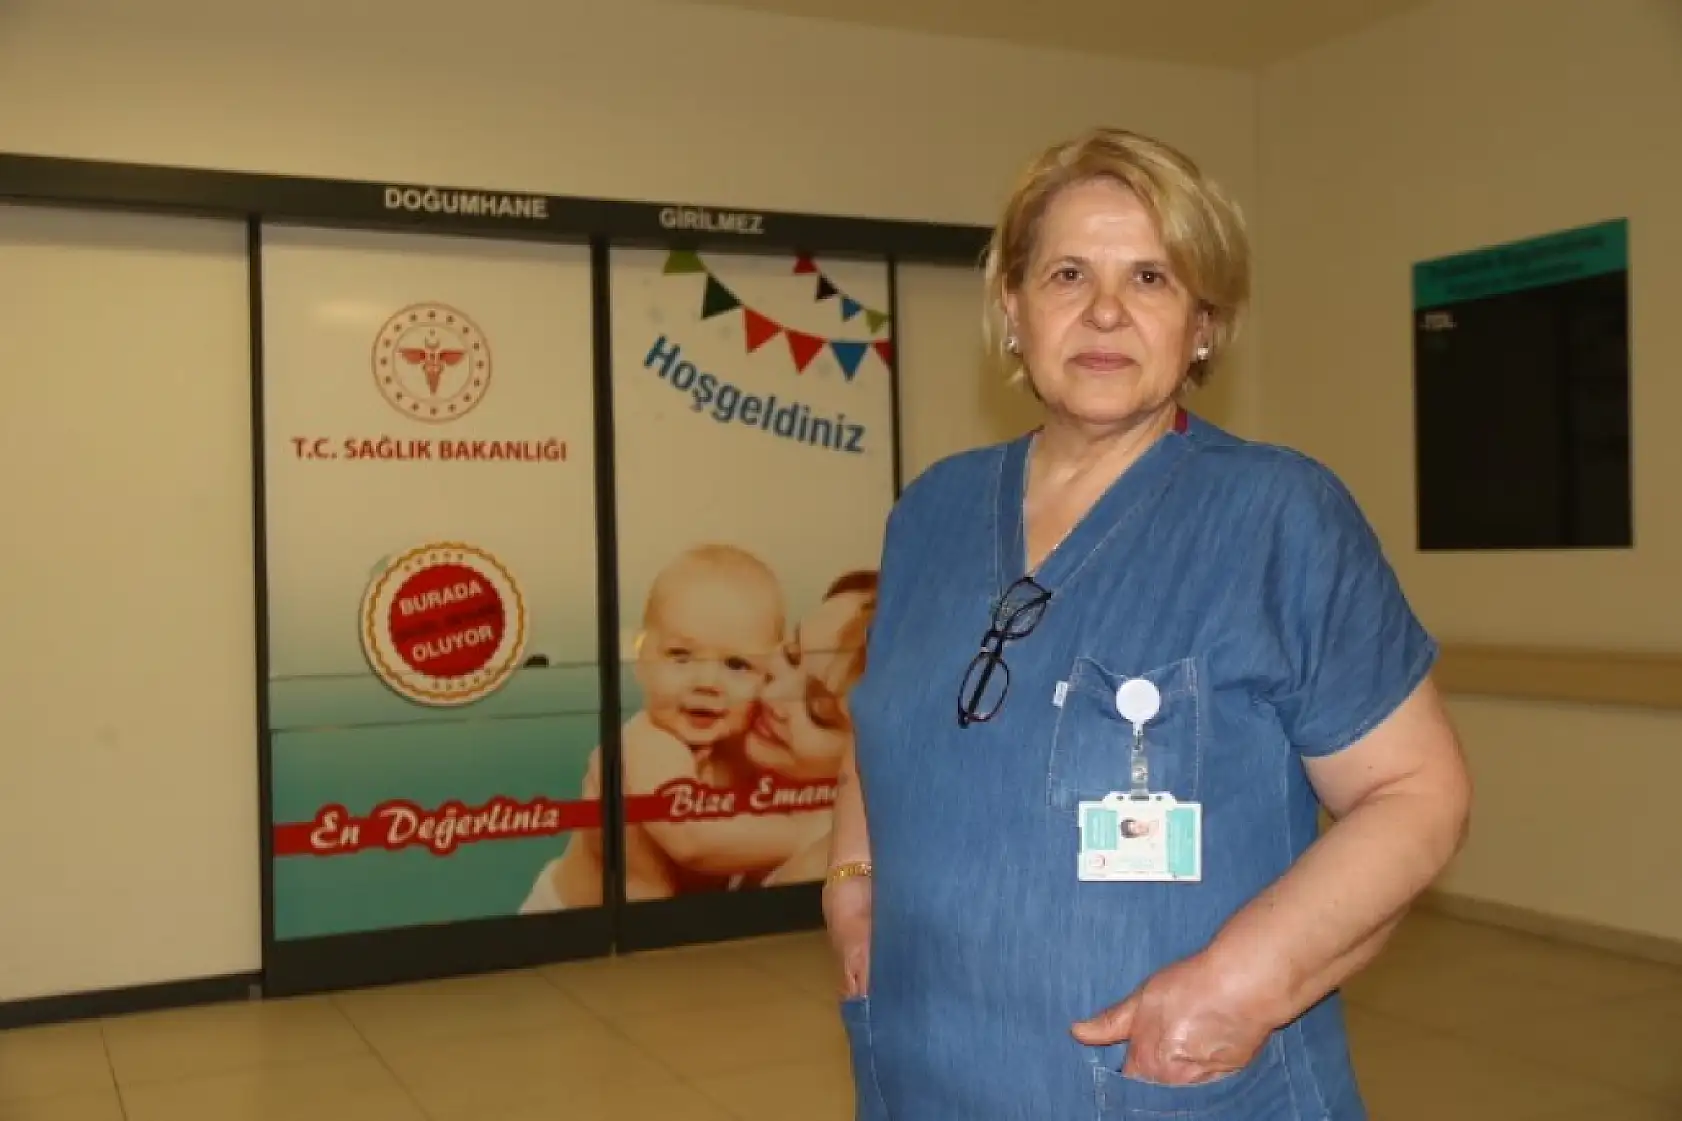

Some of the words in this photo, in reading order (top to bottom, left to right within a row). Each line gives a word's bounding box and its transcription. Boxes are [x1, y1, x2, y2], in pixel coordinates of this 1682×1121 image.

[385, 187, 548, 218] DOĞUMHANE
[660, 207, 764, 234] GİRİLMEZ
[644, 335, 866, 453] Hoşgeldiniz
[292, 437, 338, 459] T.C.
[344, 435, 432, 460] SAĞLIK
[439, 437, 567, 462] BAKANLIĞI
[400, 579, 482, 616] BURADA
[412, 625, 494, 661] OLUYOR
[661, 783, 735, 817] Bize
[310, 811, 360, 849] En
[379, 803, 560, 850] Değerliniz
